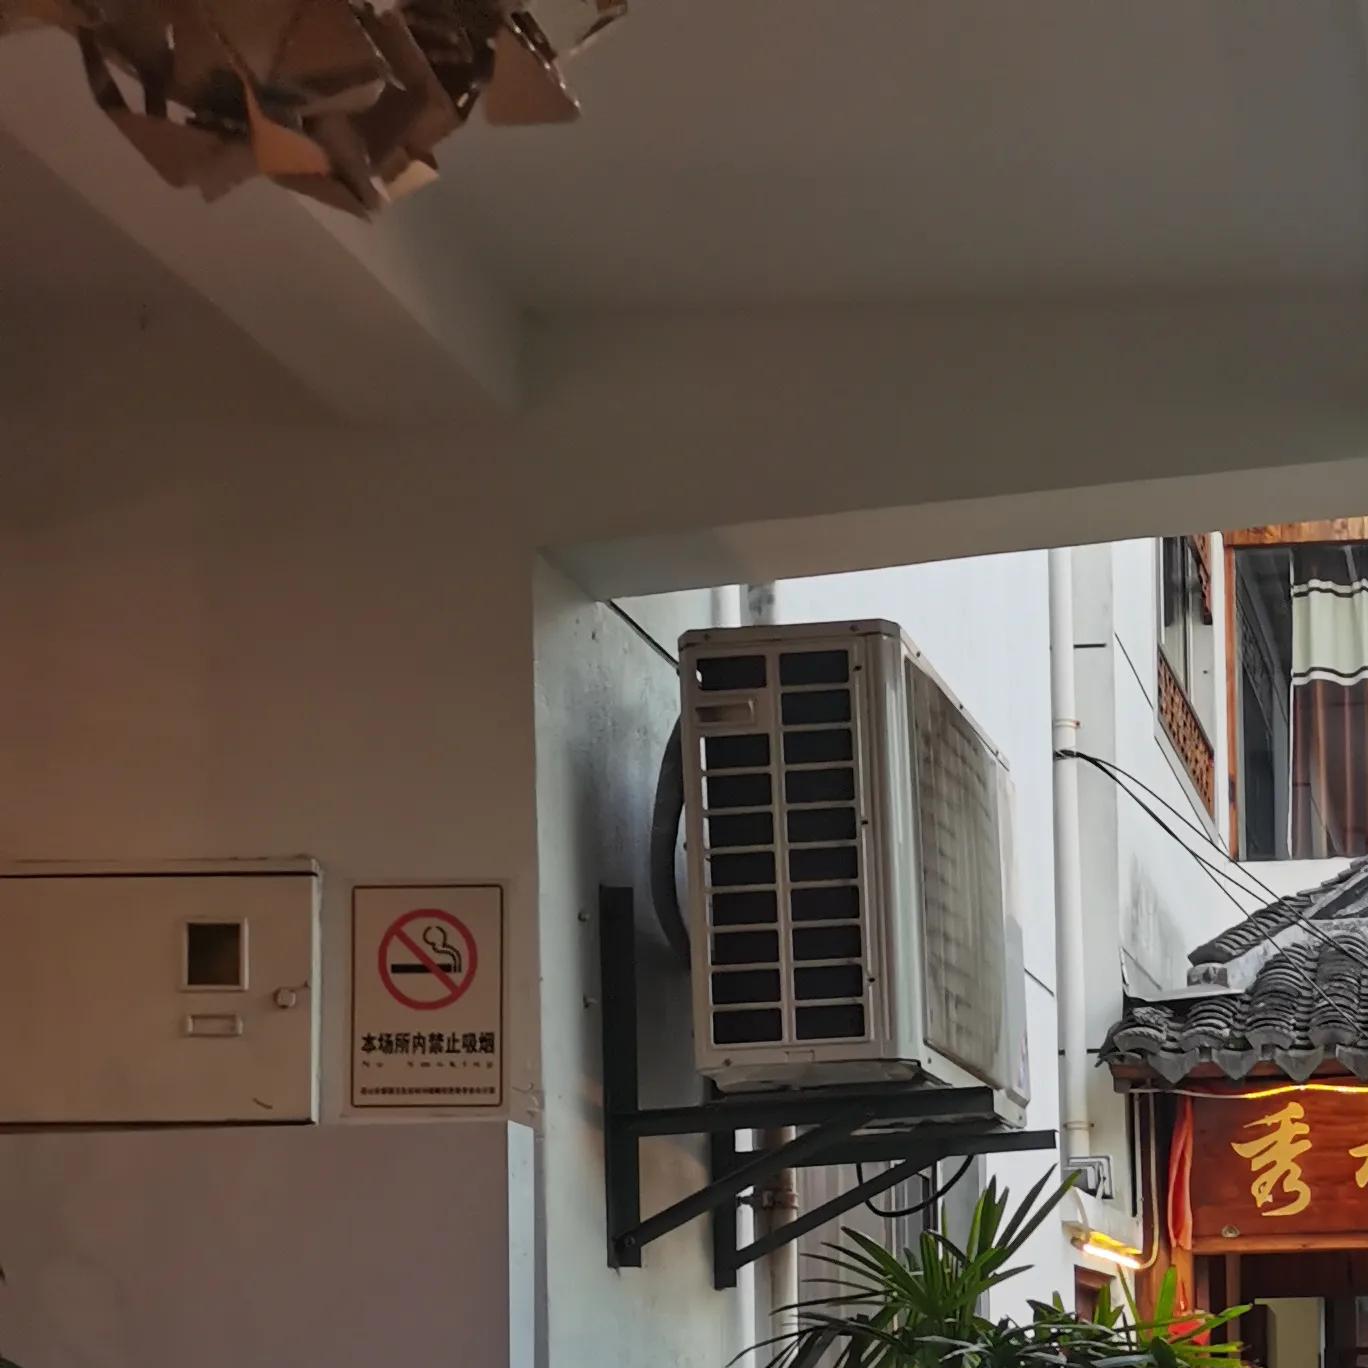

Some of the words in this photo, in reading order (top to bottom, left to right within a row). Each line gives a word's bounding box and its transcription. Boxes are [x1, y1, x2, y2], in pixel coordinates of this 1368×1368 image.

[361, 1032, 495, 1055] 本场所内禁止吸烟
